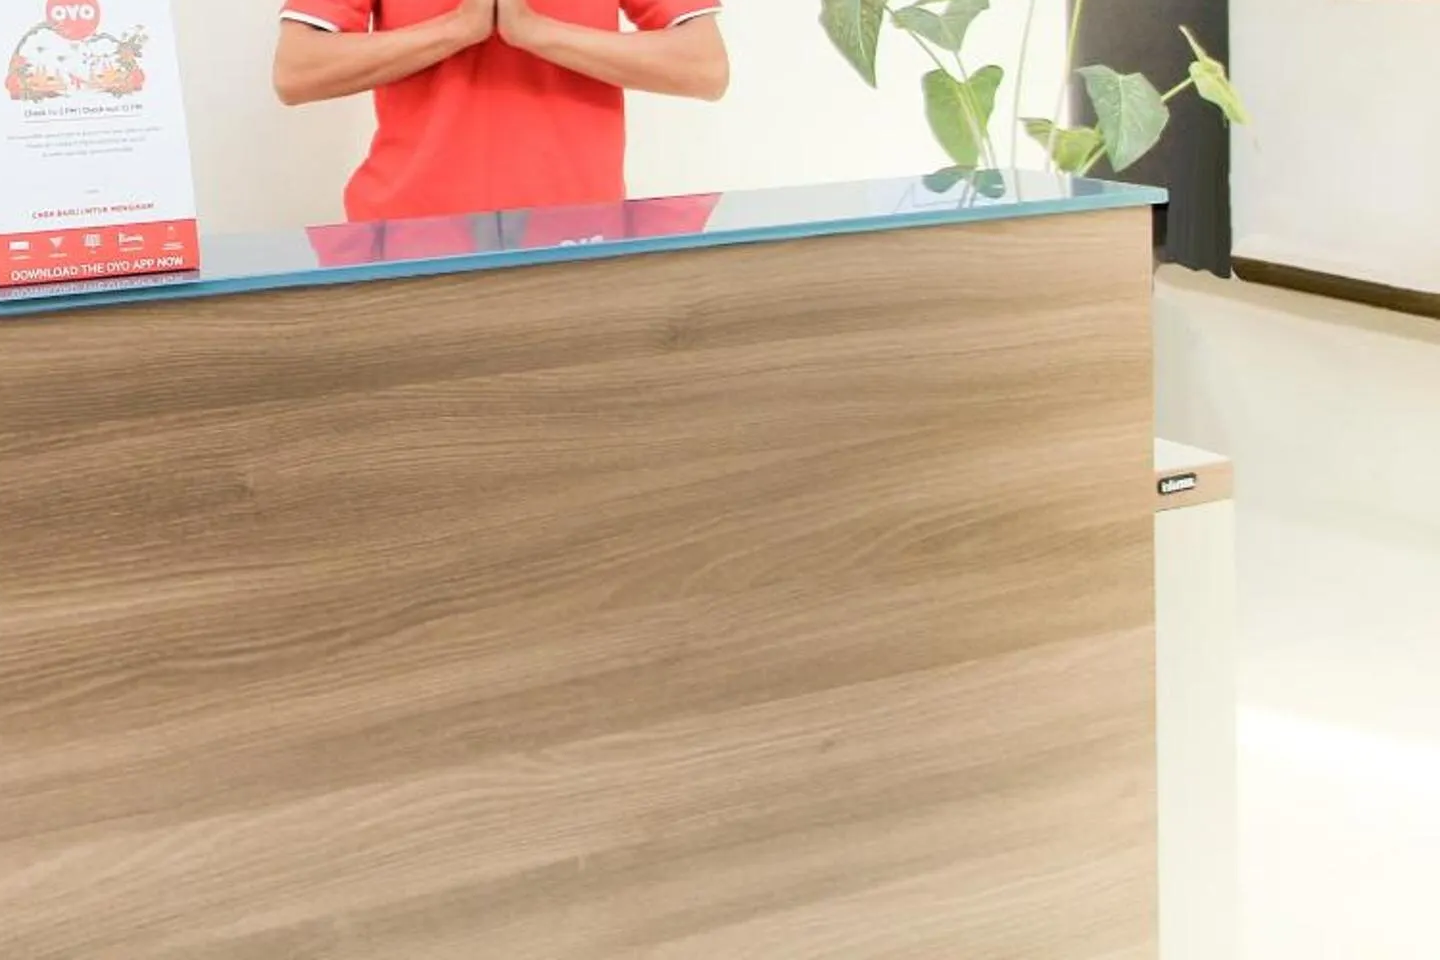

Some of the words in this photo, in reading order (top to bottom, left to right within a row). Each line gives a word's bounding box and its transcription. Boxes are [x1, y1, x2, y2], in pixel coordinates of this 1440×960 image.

[51, 4, 94, 20] OYO
[11, 266, 78, 281] DOWNLOAD
[81, 262, 104, 274] THE
[134, 257, 155, 269] APP
[158, 255, 184, 267] NOW
